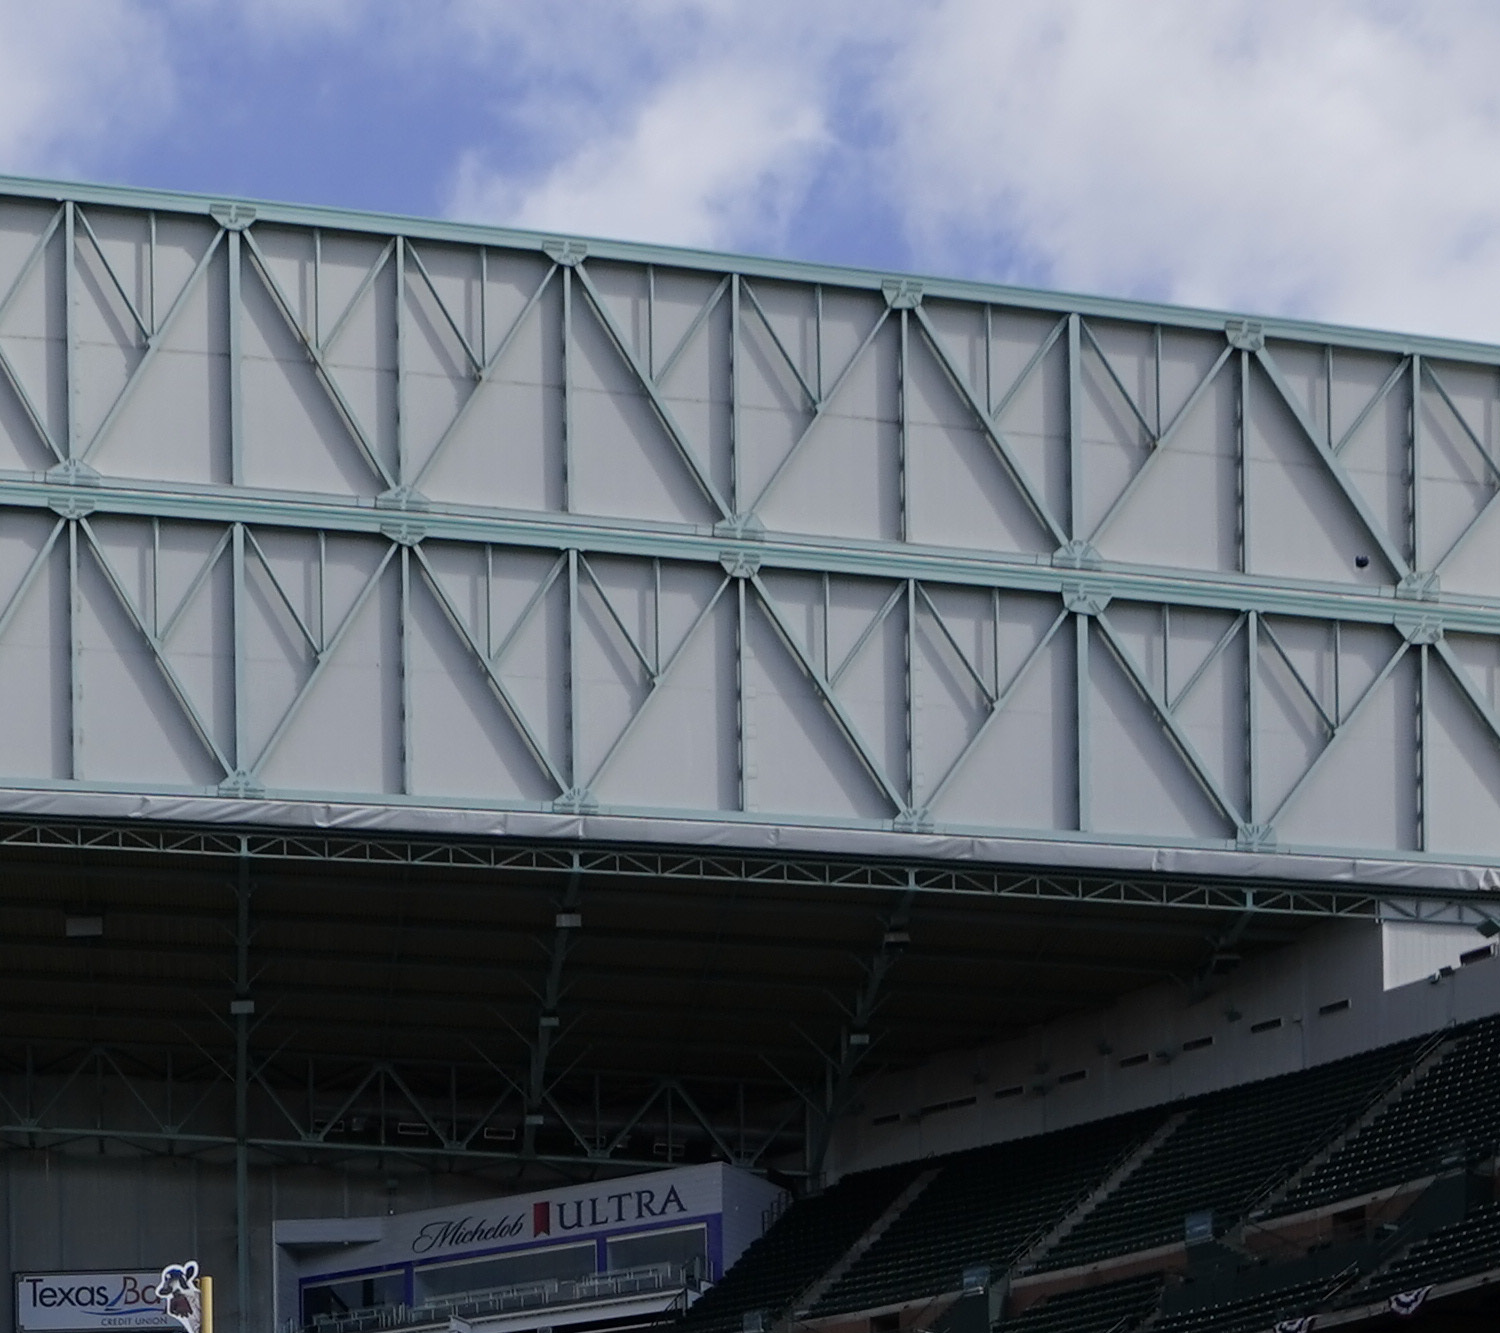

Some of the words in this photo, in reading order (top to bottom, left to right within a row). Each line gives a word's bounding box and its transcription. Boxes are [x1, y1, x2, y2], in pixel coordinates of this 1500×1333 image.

[411, 1213, 526, 1254] Michelob
[556, 1184, 688, 1233] ULTRA
[26, 1278, 109, 1307] Texas
[122, 1276, 167, 1313] Ba
[101, 1317, 132, 1326] CREDIT
[135, 1316, 168, 1326] UNION
